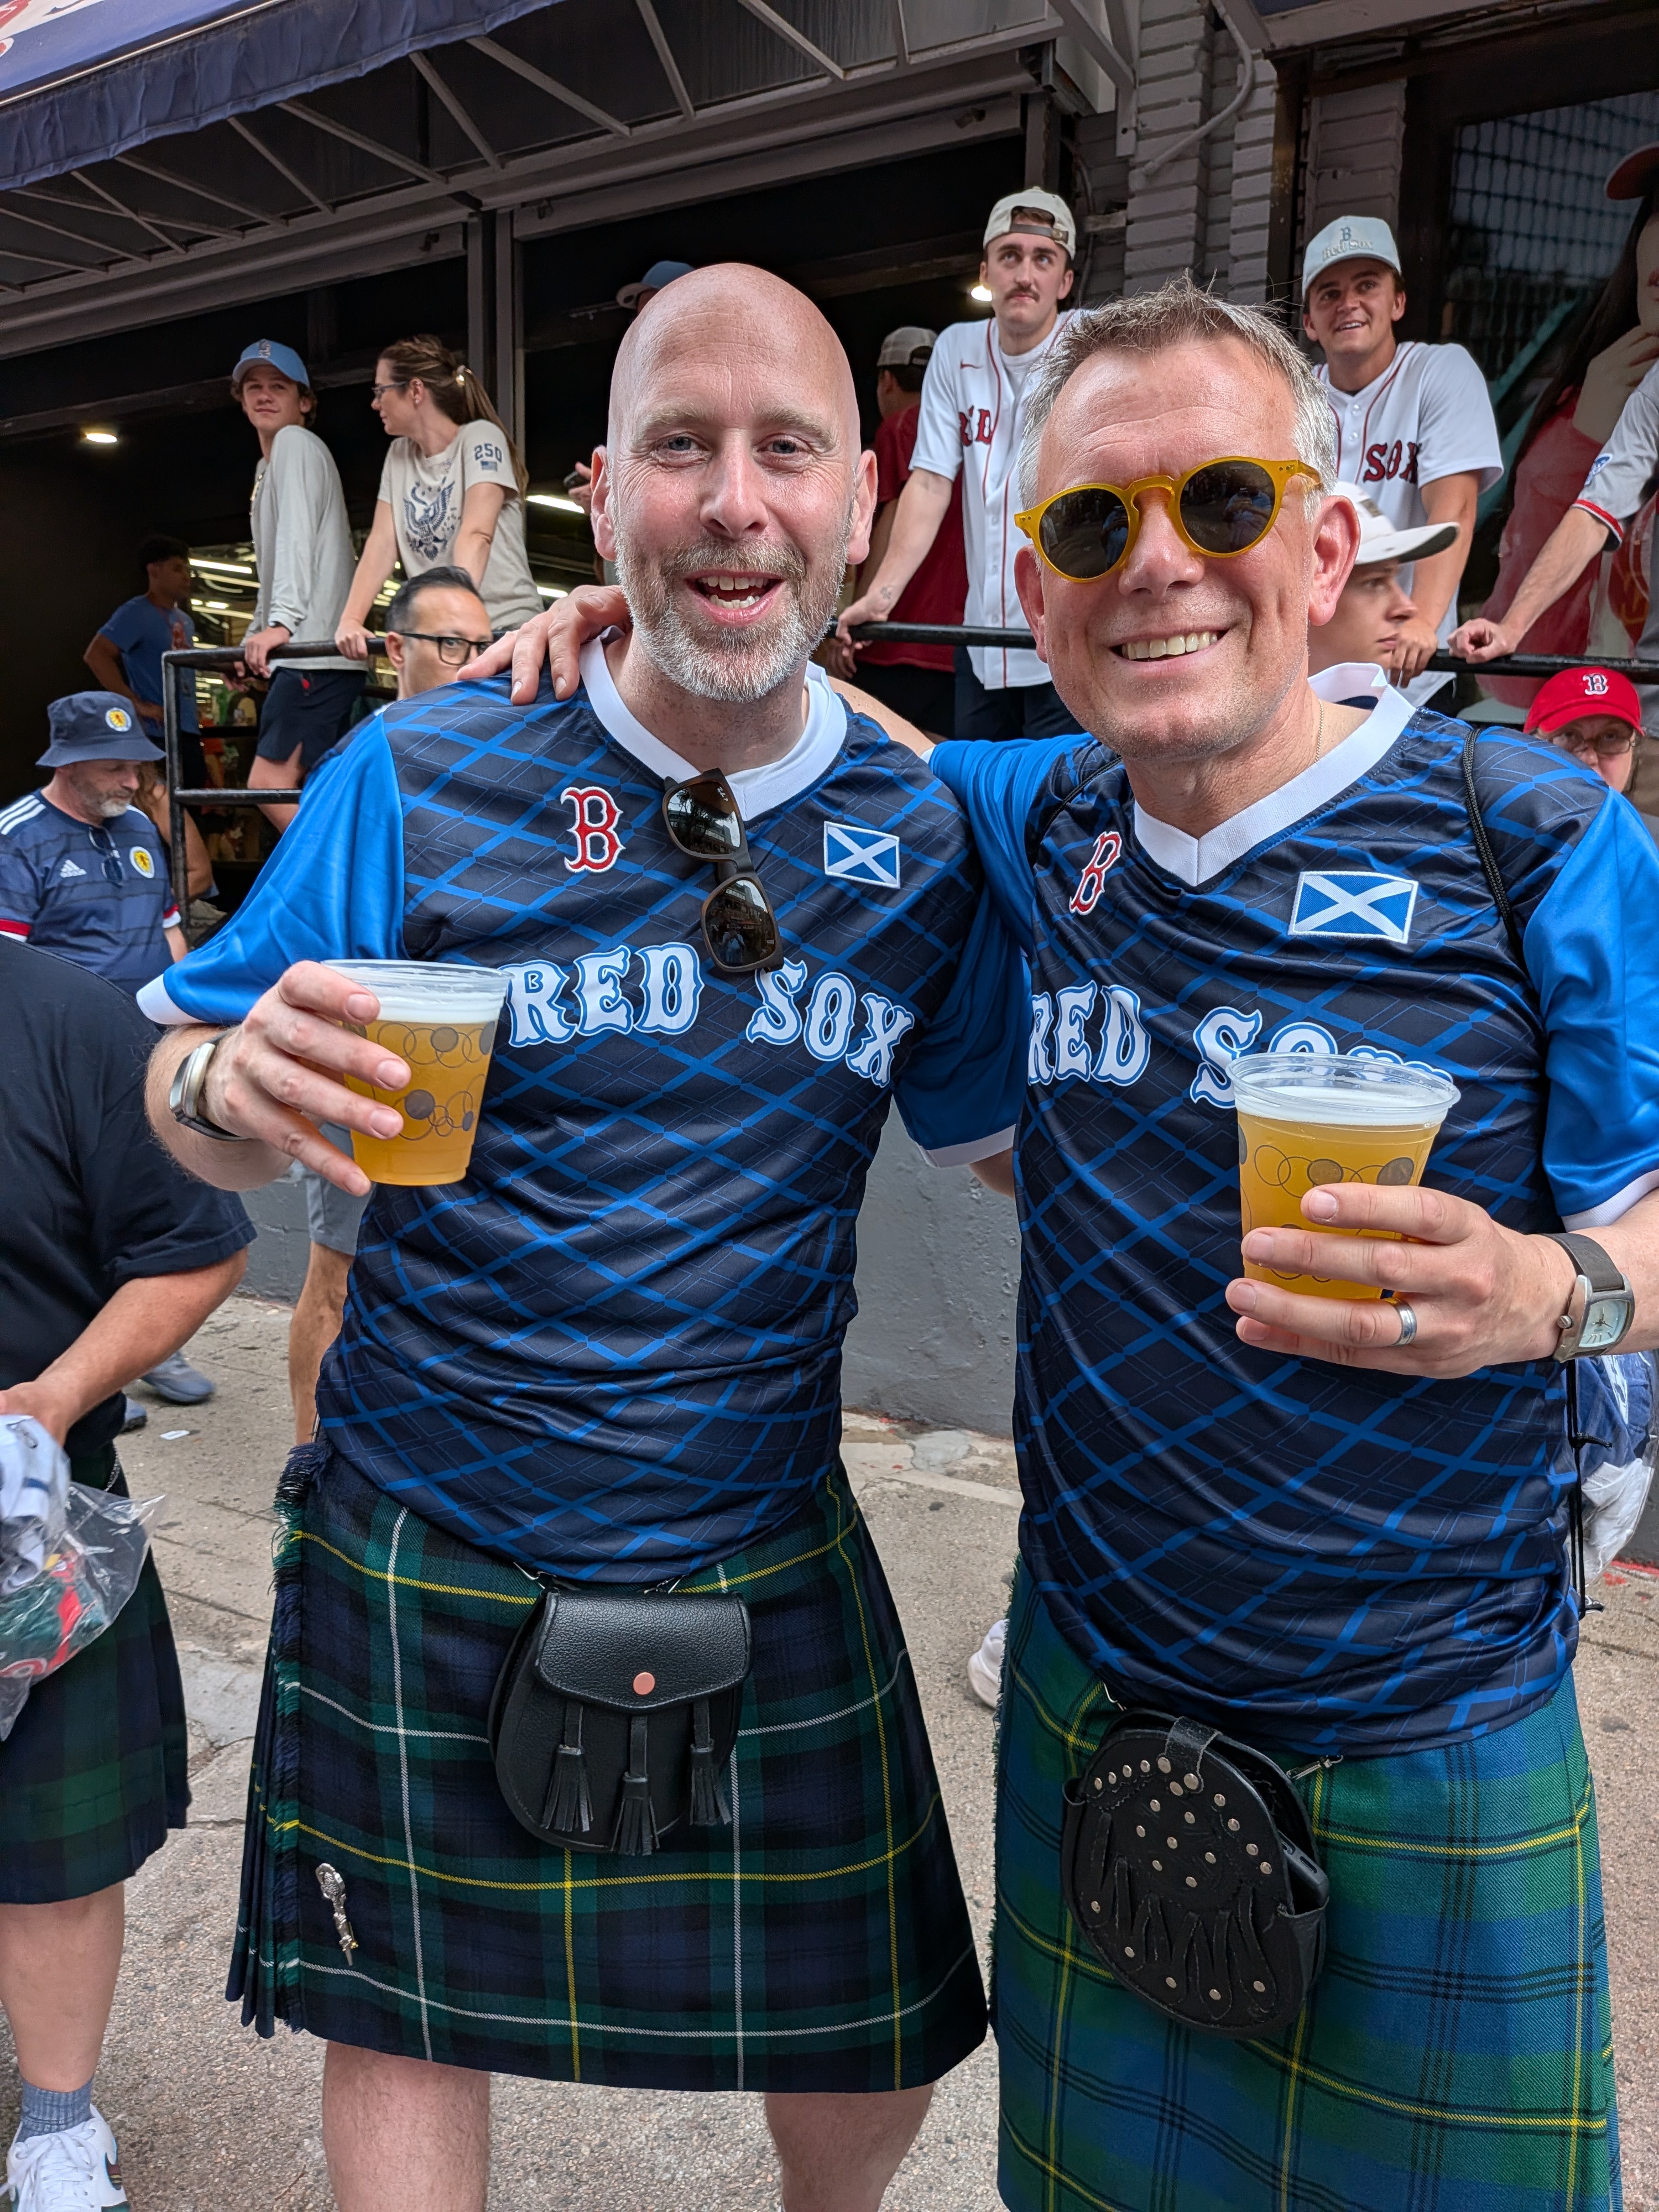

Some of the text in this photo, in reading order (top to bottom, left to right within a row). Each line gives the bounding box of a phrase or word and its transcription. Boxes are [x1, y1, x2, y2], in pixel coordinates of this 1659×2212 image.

[1340, 227, 1352, 241] B
[474, 443, 503, 463] 250
[1582, 672, 1610, 696] B
[560, 785, 627, 874] B
[1068, 830, 1121, 916] B
[505, 942, 915, 1089] RED SOX
[1028, 979, 1151, 1087] RED
